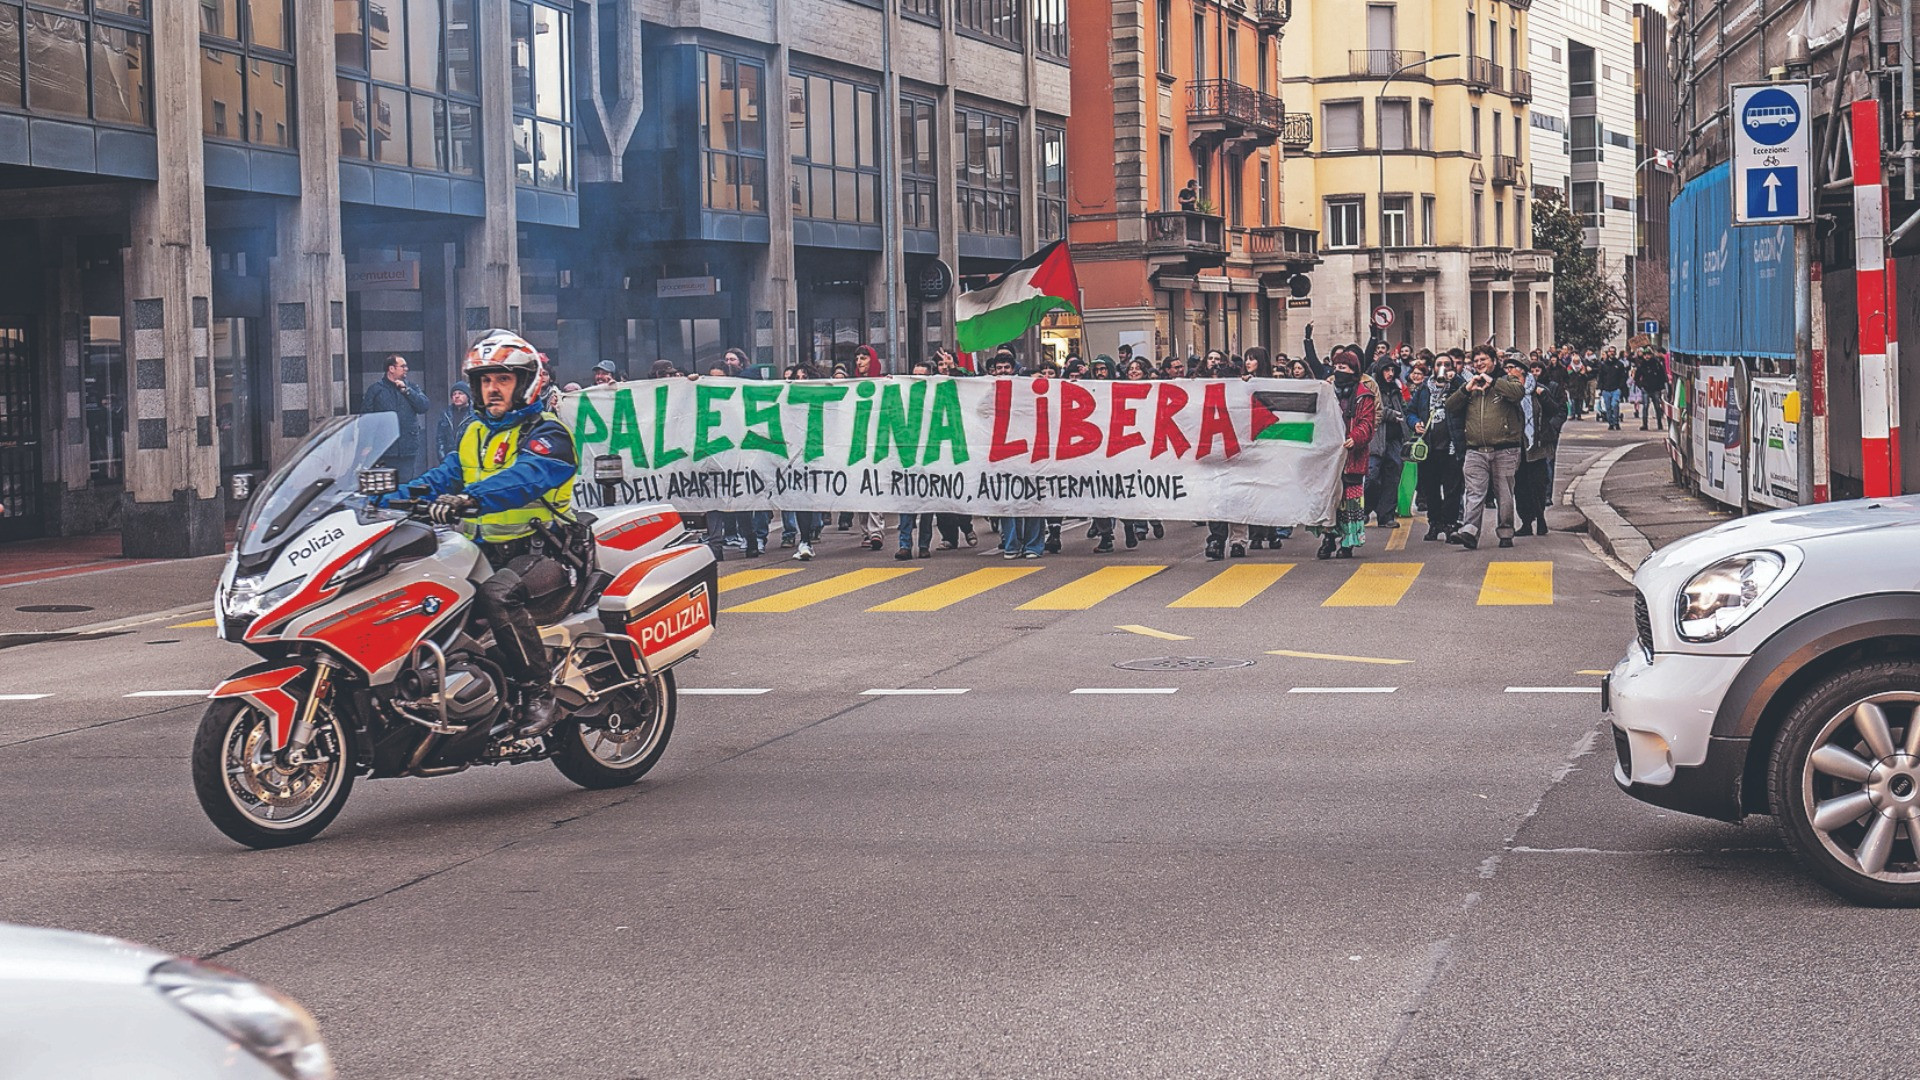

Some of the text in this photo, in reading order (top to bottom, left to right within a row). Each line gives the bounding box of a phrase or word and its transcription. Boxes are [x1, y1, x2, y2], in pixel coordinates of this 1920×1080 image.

[1753, 147, 1789, 155] Eccezione:
[483, 347, 492, 359] P
[573, 479, 602, 508] FiN
[860, 468, 884, 496] AL
[288, 528, 345, 566] Polizia
[641, 601, 705, 649] POLIZIA
